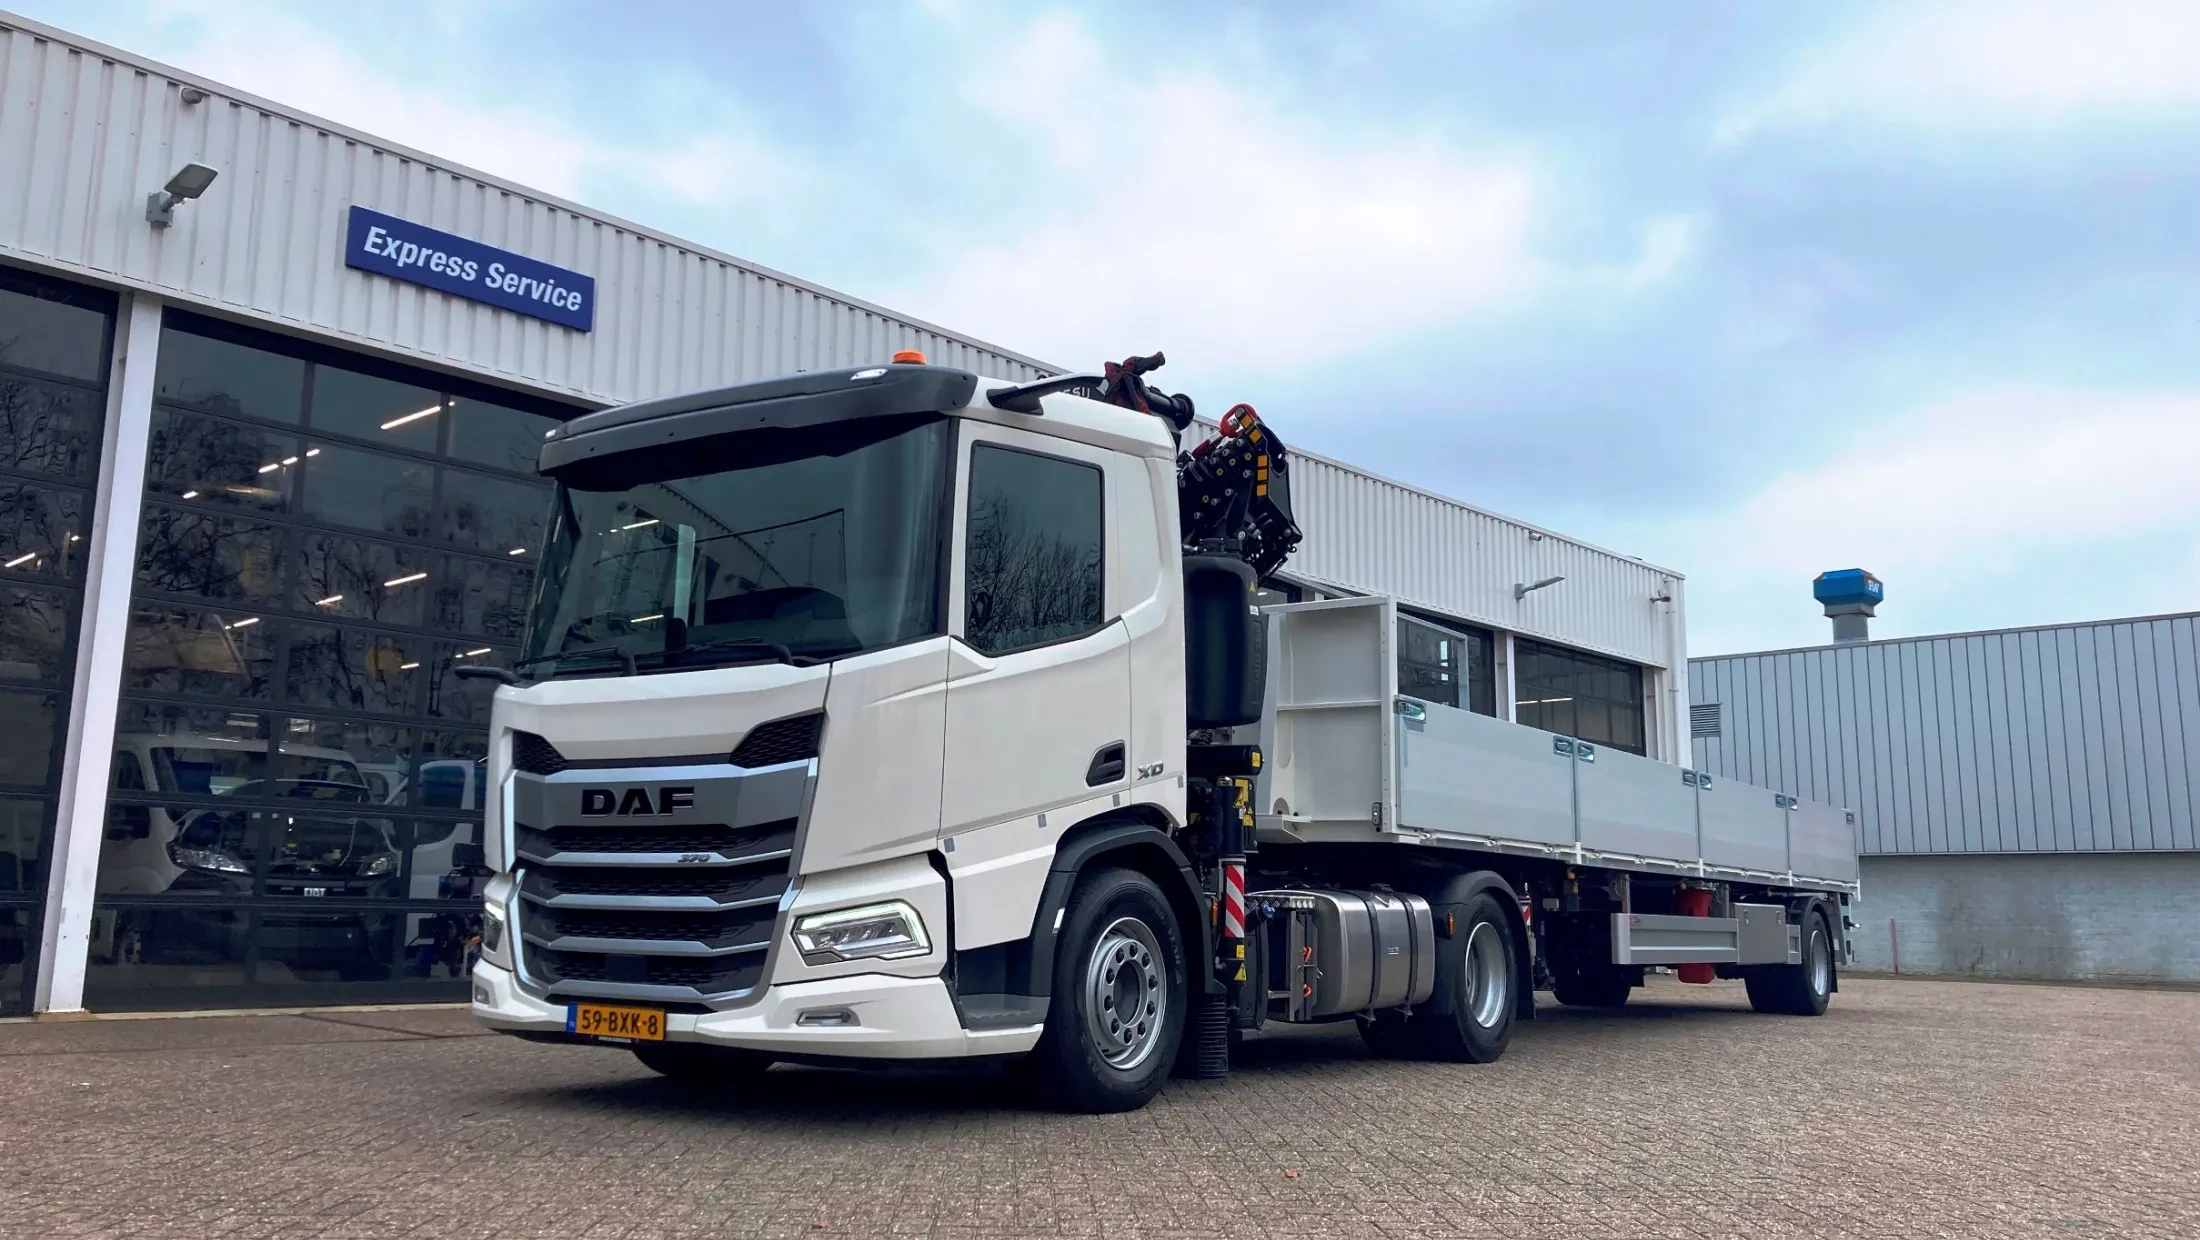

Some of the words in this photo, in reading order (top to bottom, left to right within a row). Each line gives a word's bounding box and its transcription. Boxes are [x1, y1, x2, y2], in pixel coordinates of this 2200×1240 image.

[363, 225, 478, 282] Express
[484, 262, 582, 312] Service
[1136, 760, 1164, 780] XD
[580, 786, 695, 817] DAF
[582, 1009, 658, 1036] 59-BXK-8
